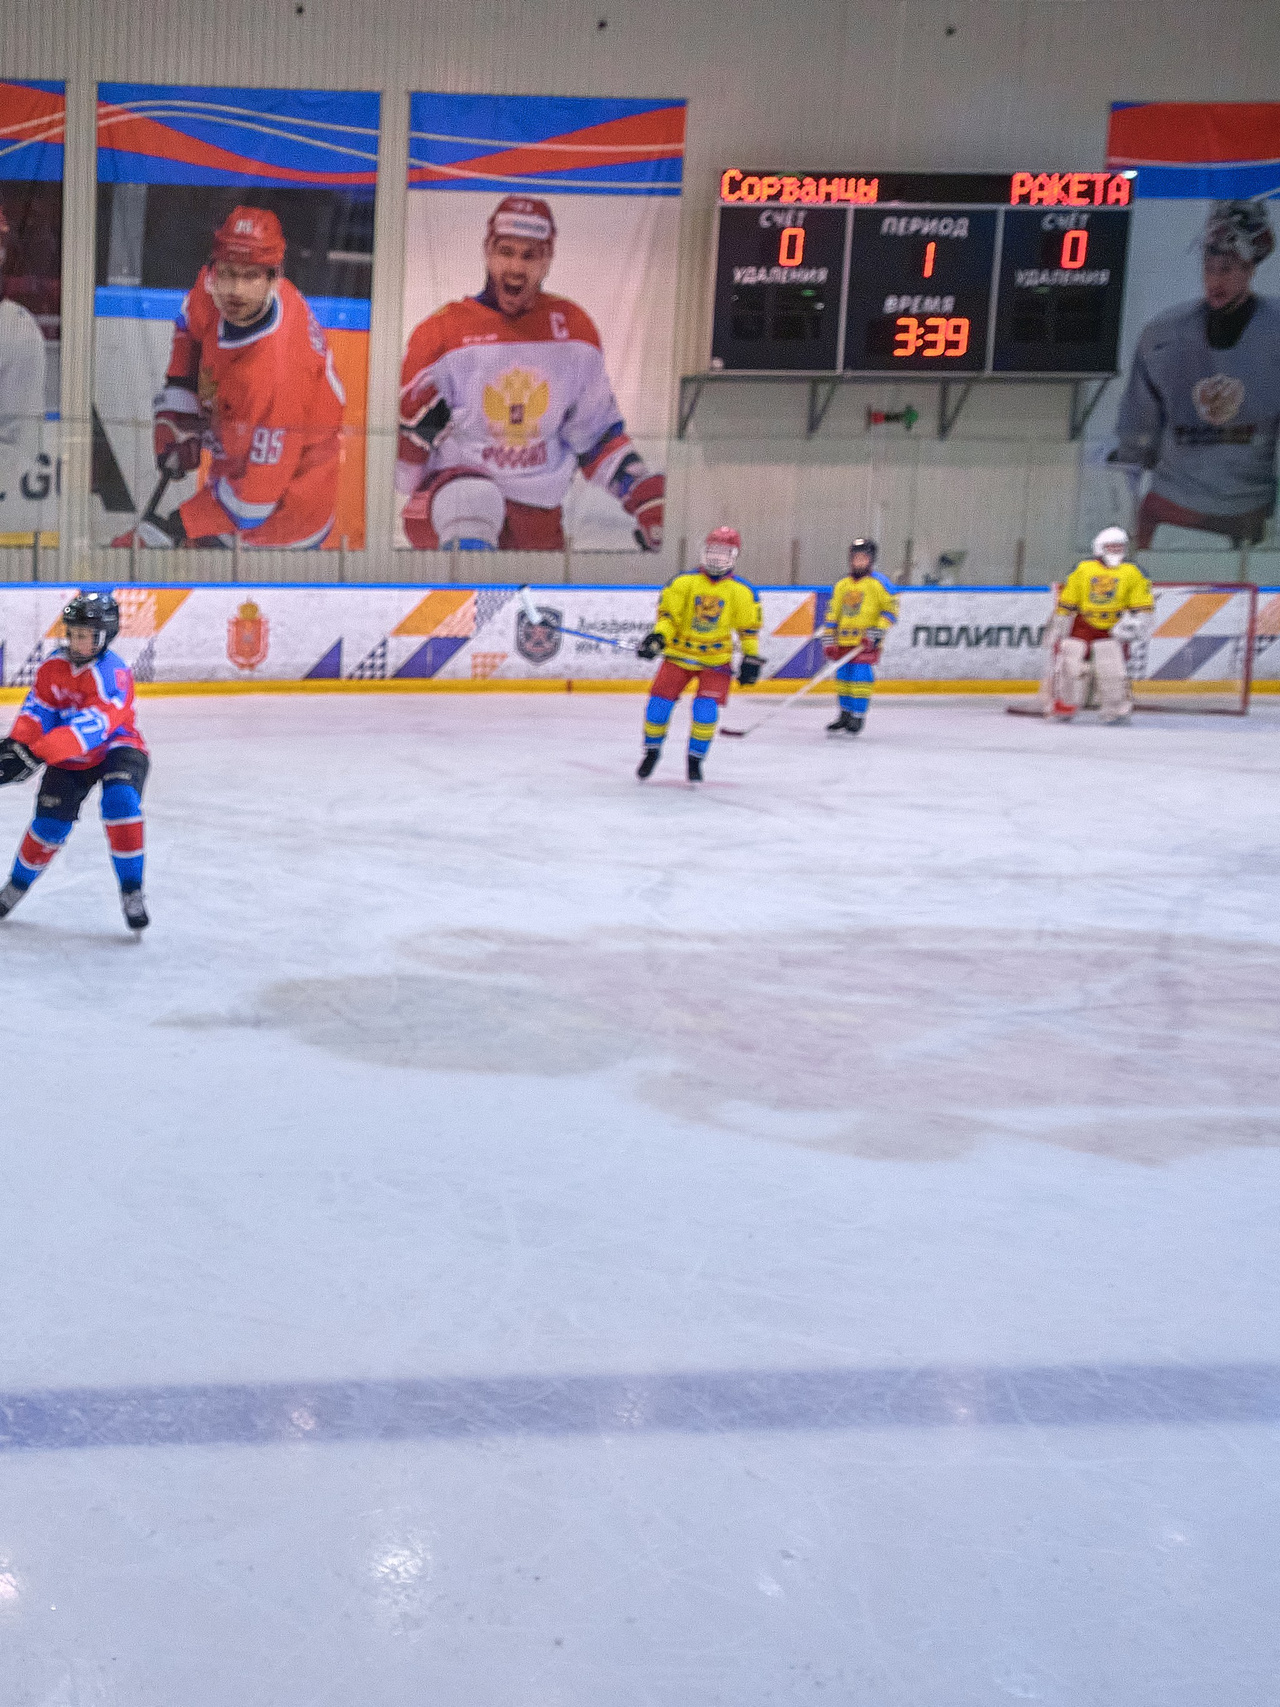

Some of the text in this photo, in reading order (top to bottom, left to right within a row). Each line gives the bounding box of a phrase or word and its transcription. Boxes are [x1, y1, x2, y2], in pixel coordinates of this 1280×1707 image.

[721, 168, 879, 204] Сорванцы
[1010, 172, 1130, 206] РАКЕТА
[880, 216, 969, 239] ПЕРИОД
[779, 227, 805, 267] 0
[923, 241, 936, 278] 1
[1061, 229, 1088, 269] 0
[733, 266, 829, 285] УДАЛЕНИЯ
[1013, 268, 1110, 288] УДАЛЕНИЯ
[882, 294, 955, 315] ВРЕМЯ
[893, 317, 970, 357] 3:39
[250, 427, 286, 464] 95
